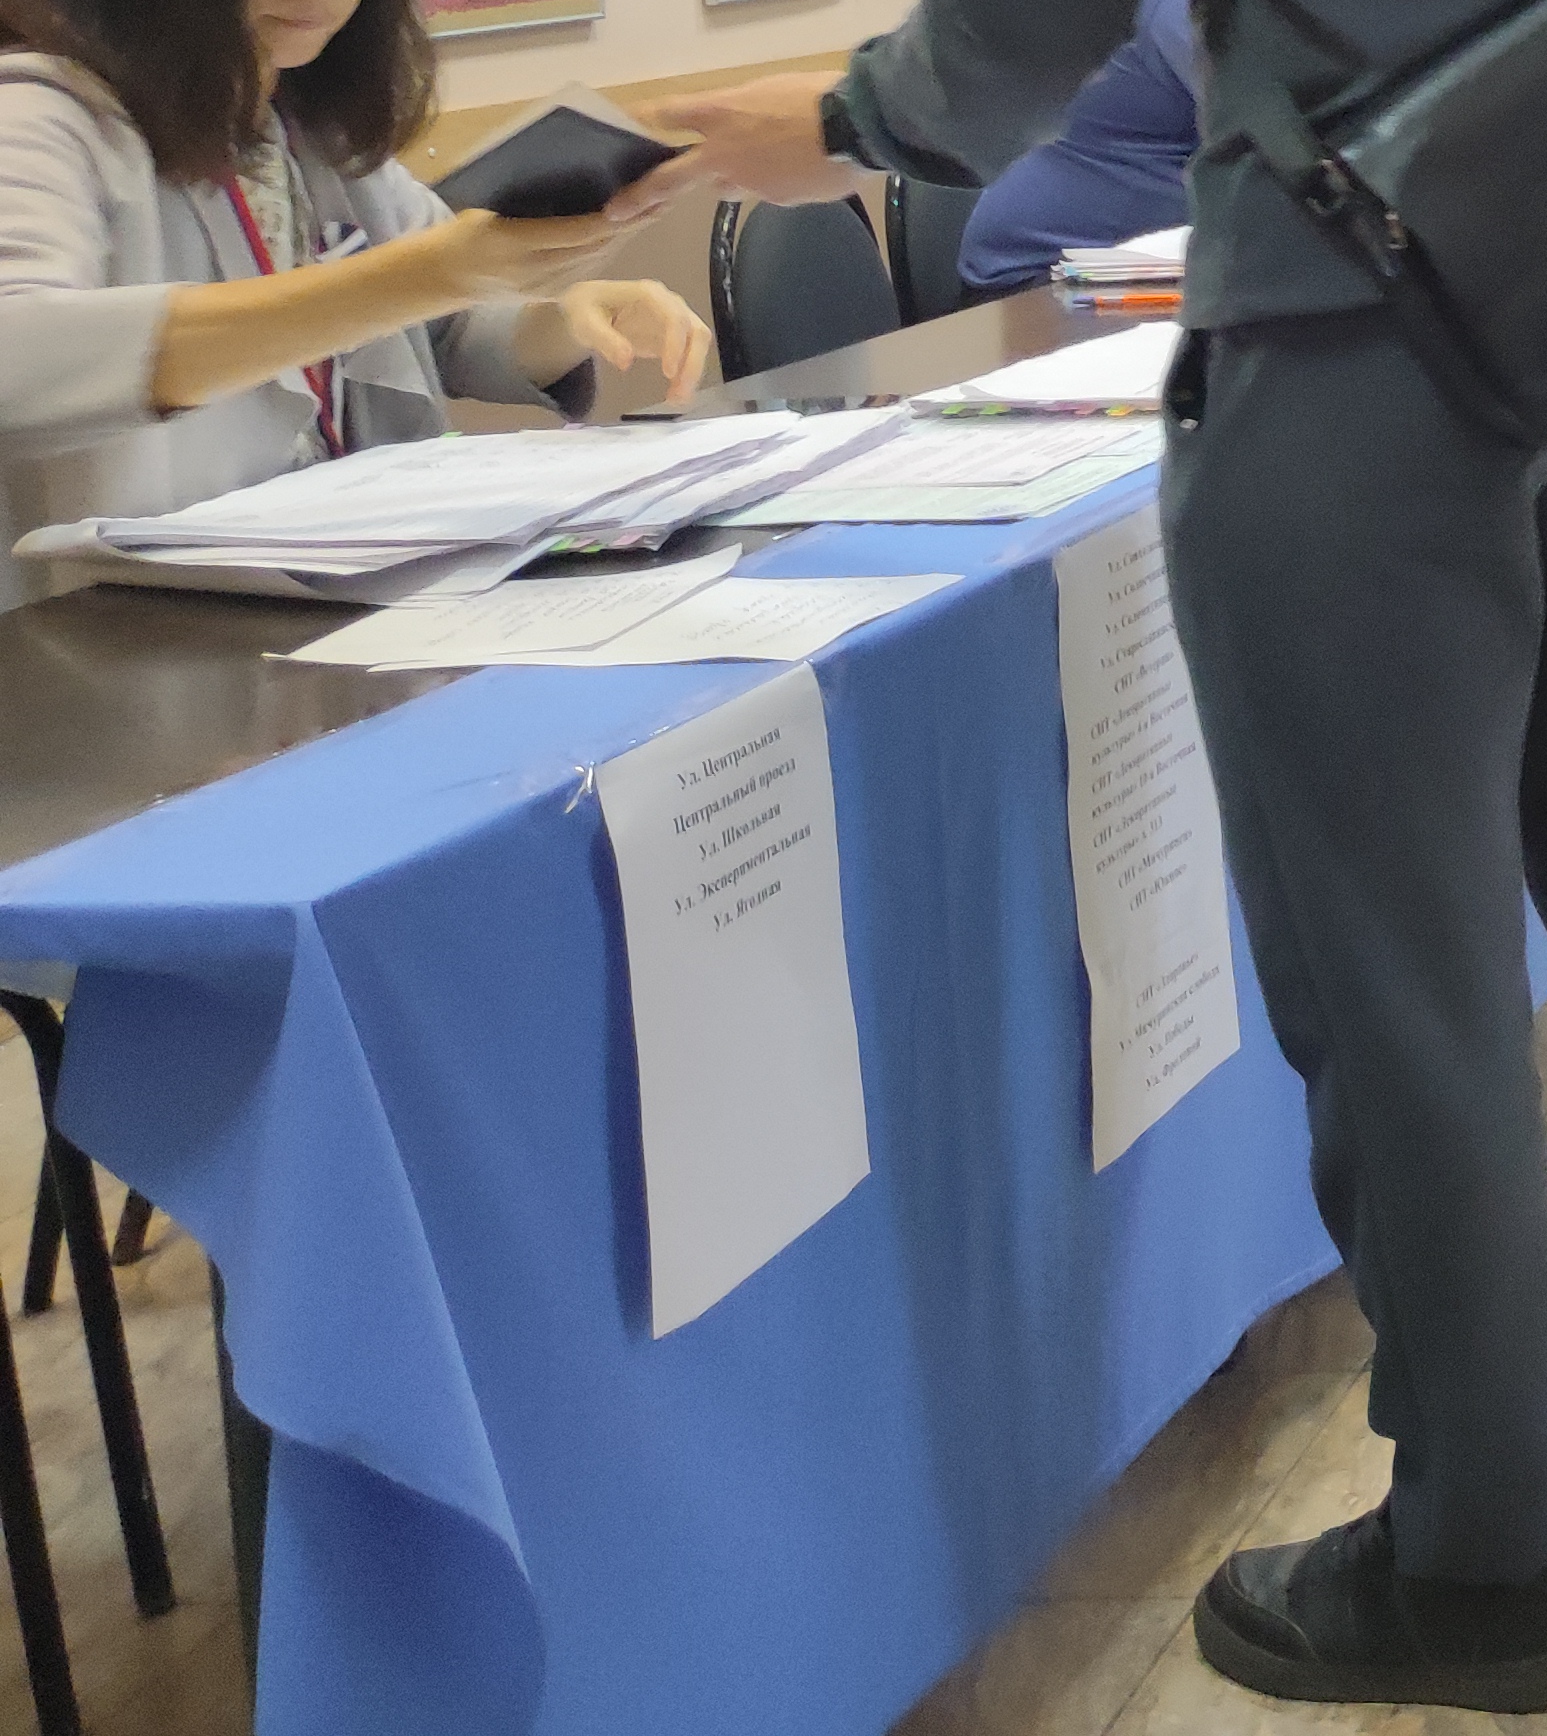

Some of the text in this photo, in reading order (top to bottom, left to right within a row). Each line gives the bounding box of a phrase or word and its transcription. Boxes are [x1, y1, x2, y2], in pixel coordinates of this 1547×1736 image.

[677, 727, 781, 791] Ул. Центральная
[673, 758, 796, 834] Центральный проезд
[699, 803, 781, 862] Ул. Школьная
[674, 824, 811, 916] Ул. Экспериментальная
[713, 880, 782, 933] Ул. Ягодная
